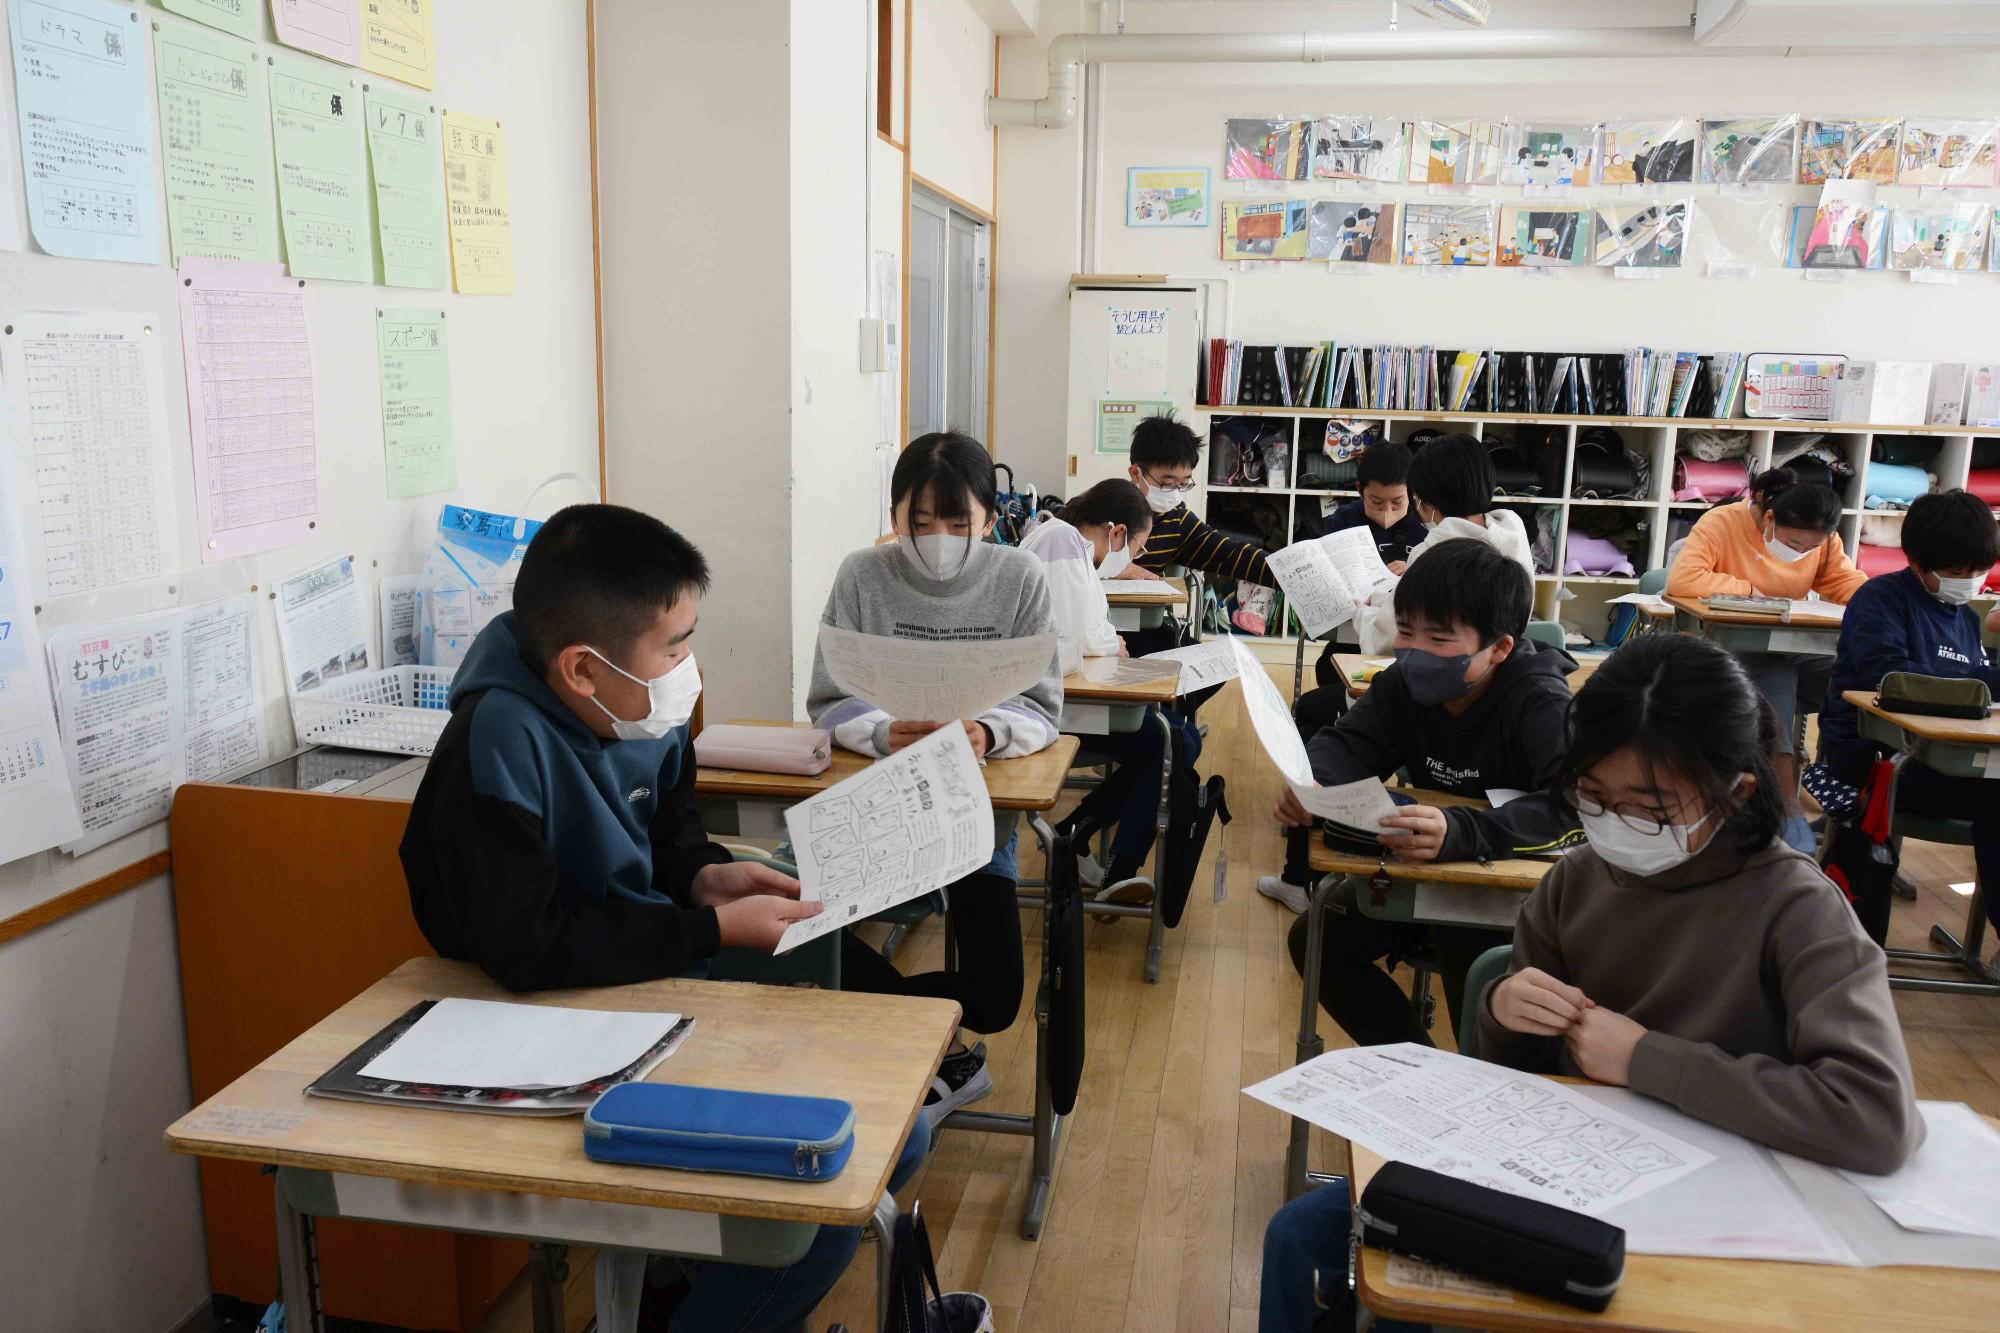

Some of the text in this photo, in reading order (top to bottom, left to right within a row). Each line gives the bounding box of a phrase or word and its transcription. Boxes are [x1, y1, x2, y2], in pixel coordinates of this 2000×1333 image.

[41, 20, 84, 45] ドラマ
[1111, 310, 1166, 324] そうじ用具を
[388, 326, 431, 349] スポーツ
[73, 649, 127, 681] むすび
[1937, 649, 1970, 664] ATHLETA
[1426, 757, 1445, 771] THE
